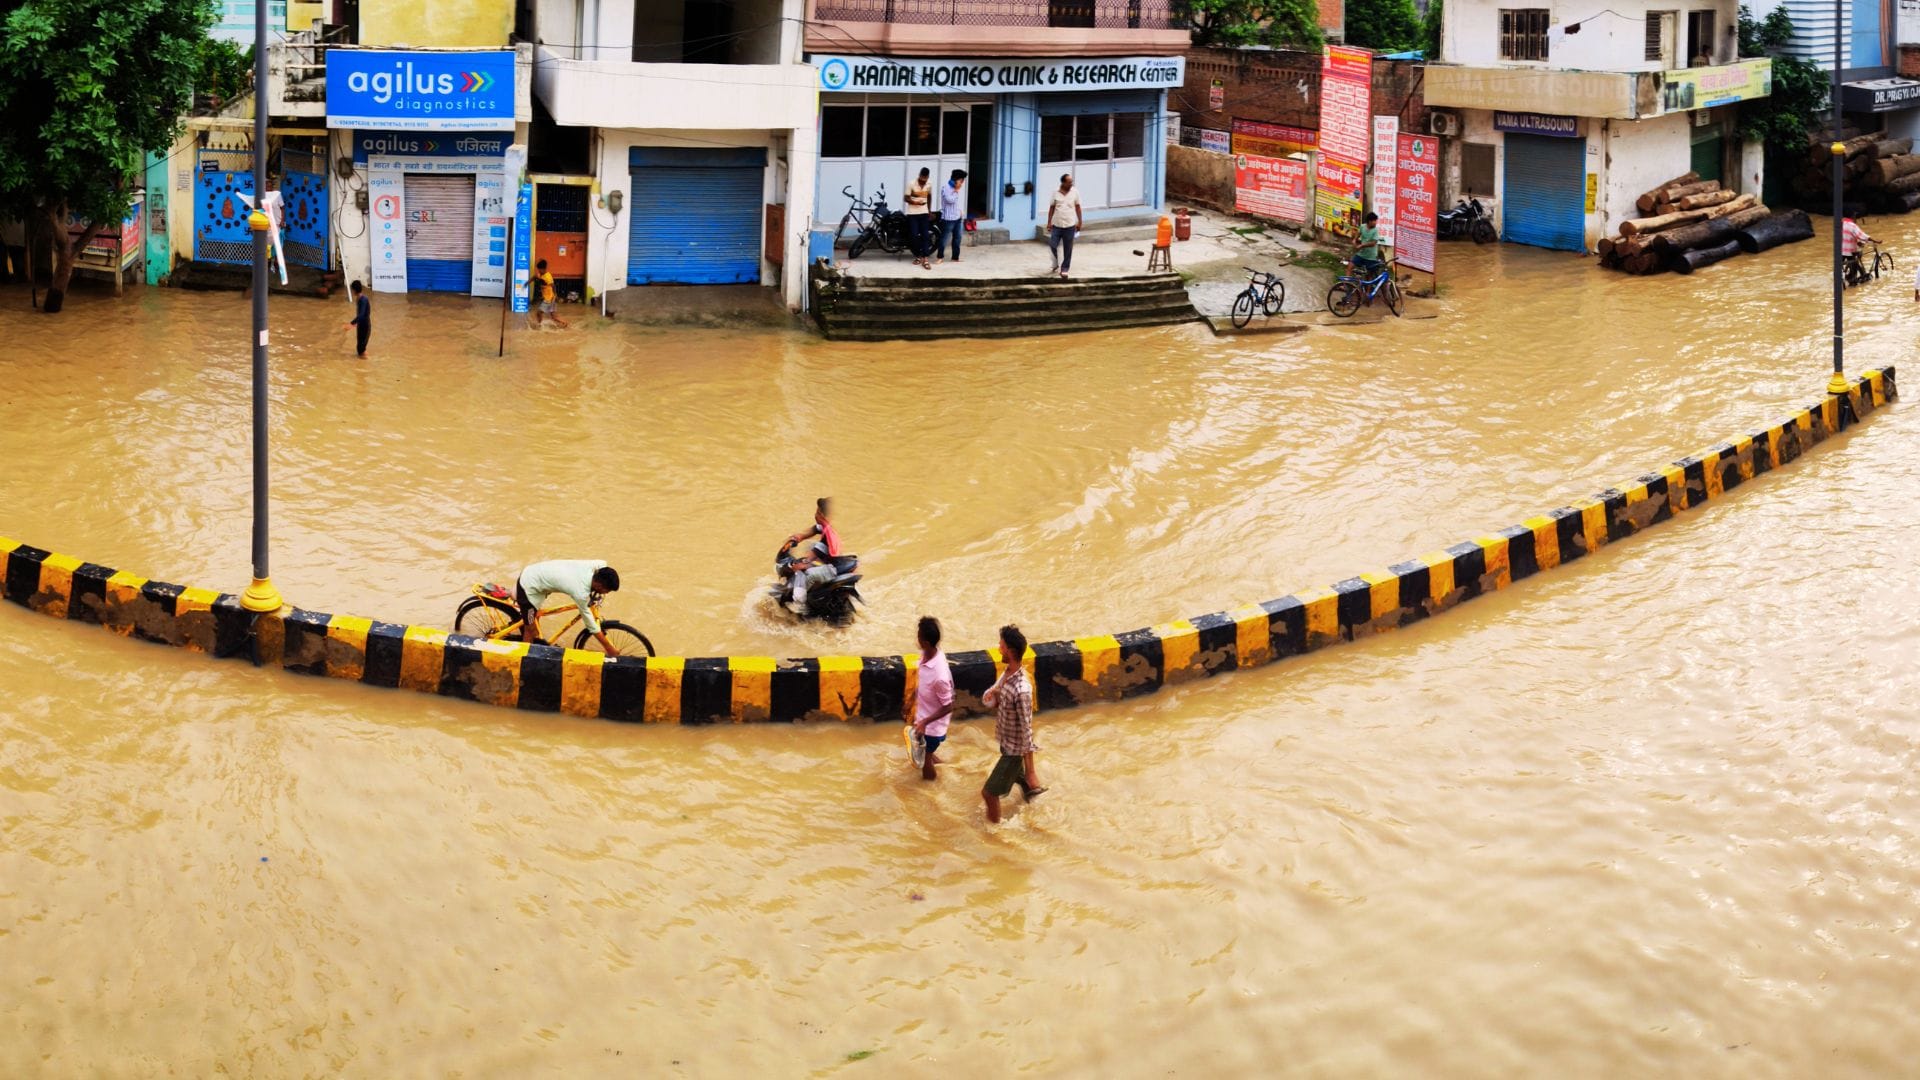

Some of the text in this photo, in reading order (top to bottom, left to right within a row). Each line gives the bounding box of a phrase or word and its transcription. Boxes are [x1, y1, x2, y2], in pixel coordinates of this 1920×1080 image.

[348, 62, 453, 103] agilus
[853, 64, 1178, 87] KAMAL HOMEO CLINIC & RESEARCH CENTER
[395, 98, 496, 113] diagnostics
[1496, 113, 1575, 132] VAMA ULTRASOUND
[362, 134, 419, 155] agilus
[455, 137, 500, 152] एजिलस
[371, 179, 392, 187] agilus
[1408, 173, 1425, 187] श्री
[411, 210, 437, 222] SRL
